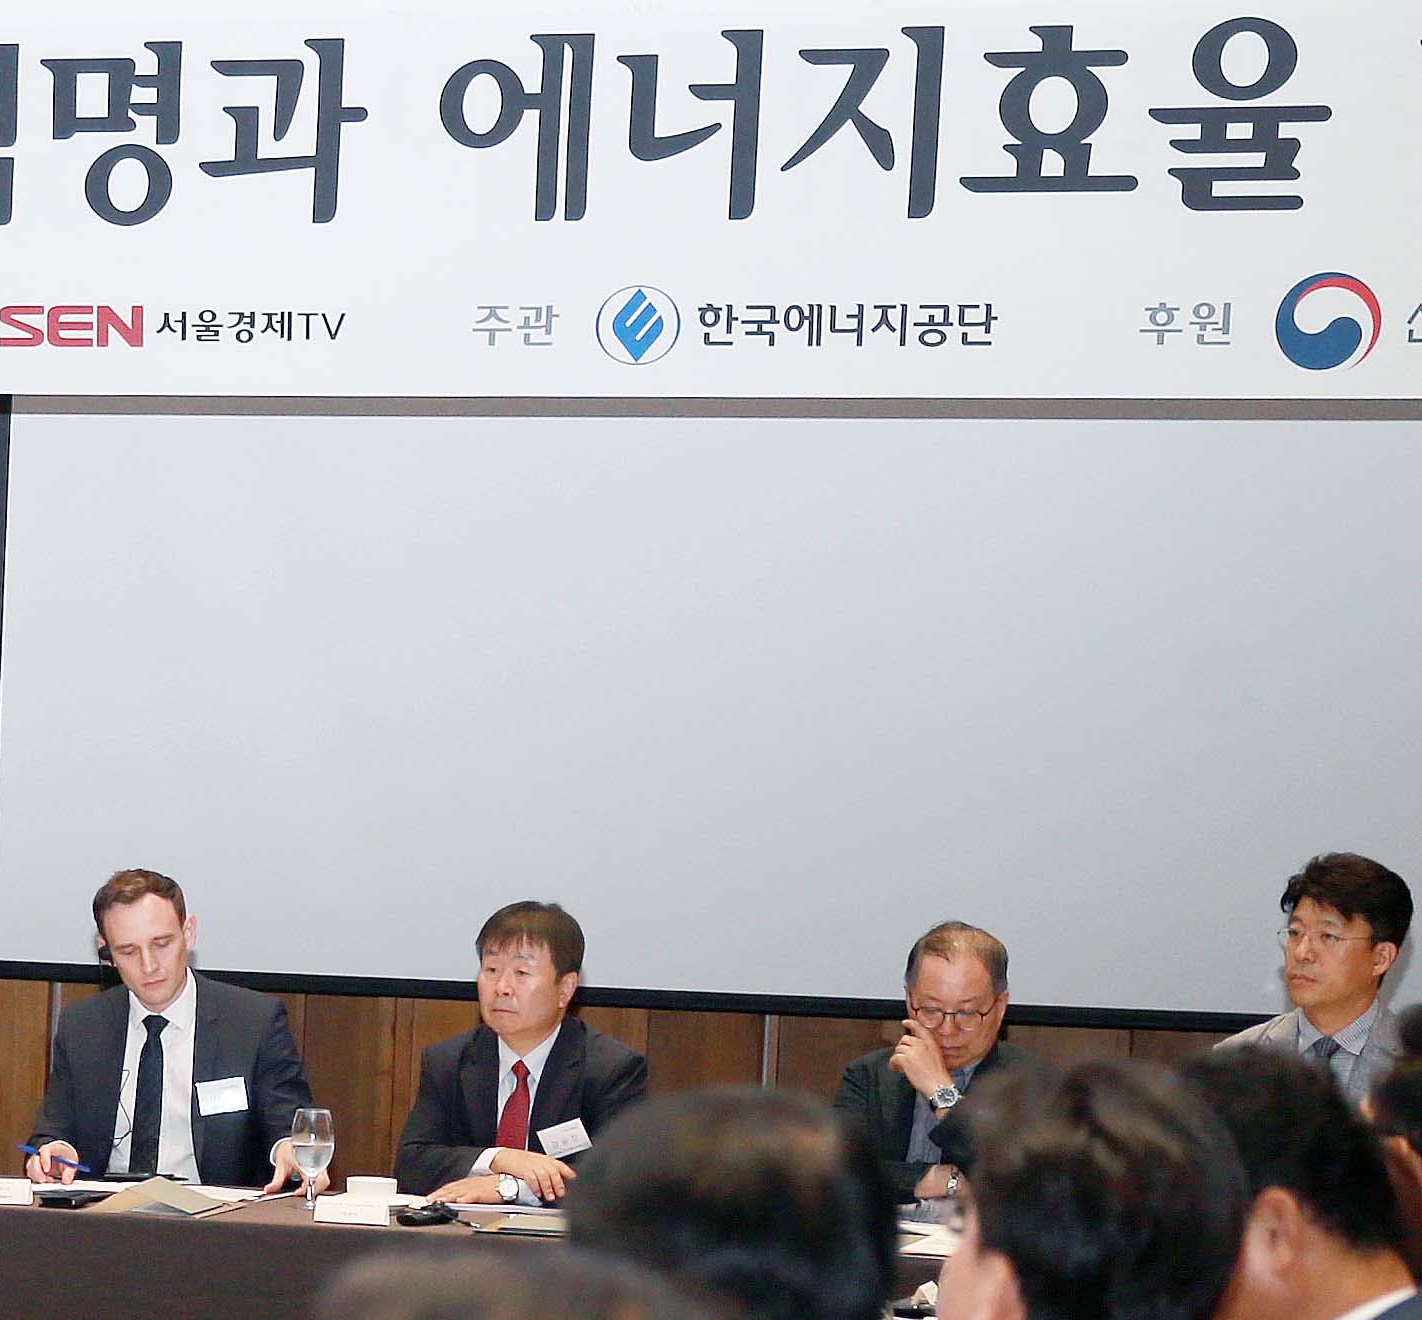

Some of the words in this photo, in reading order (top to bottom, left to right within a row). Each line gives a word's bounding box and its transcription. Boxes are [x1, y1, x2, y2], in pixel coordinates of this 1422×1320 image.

[438, 16, 1333, 222] 에너지효율
[155, 309, 347, 344] 서울경제TV
[472, 304, 560, 347] 주관
[697, 302, 999, 348] 한국에너지공단
[1138, 301, 1232, 346] 후원
